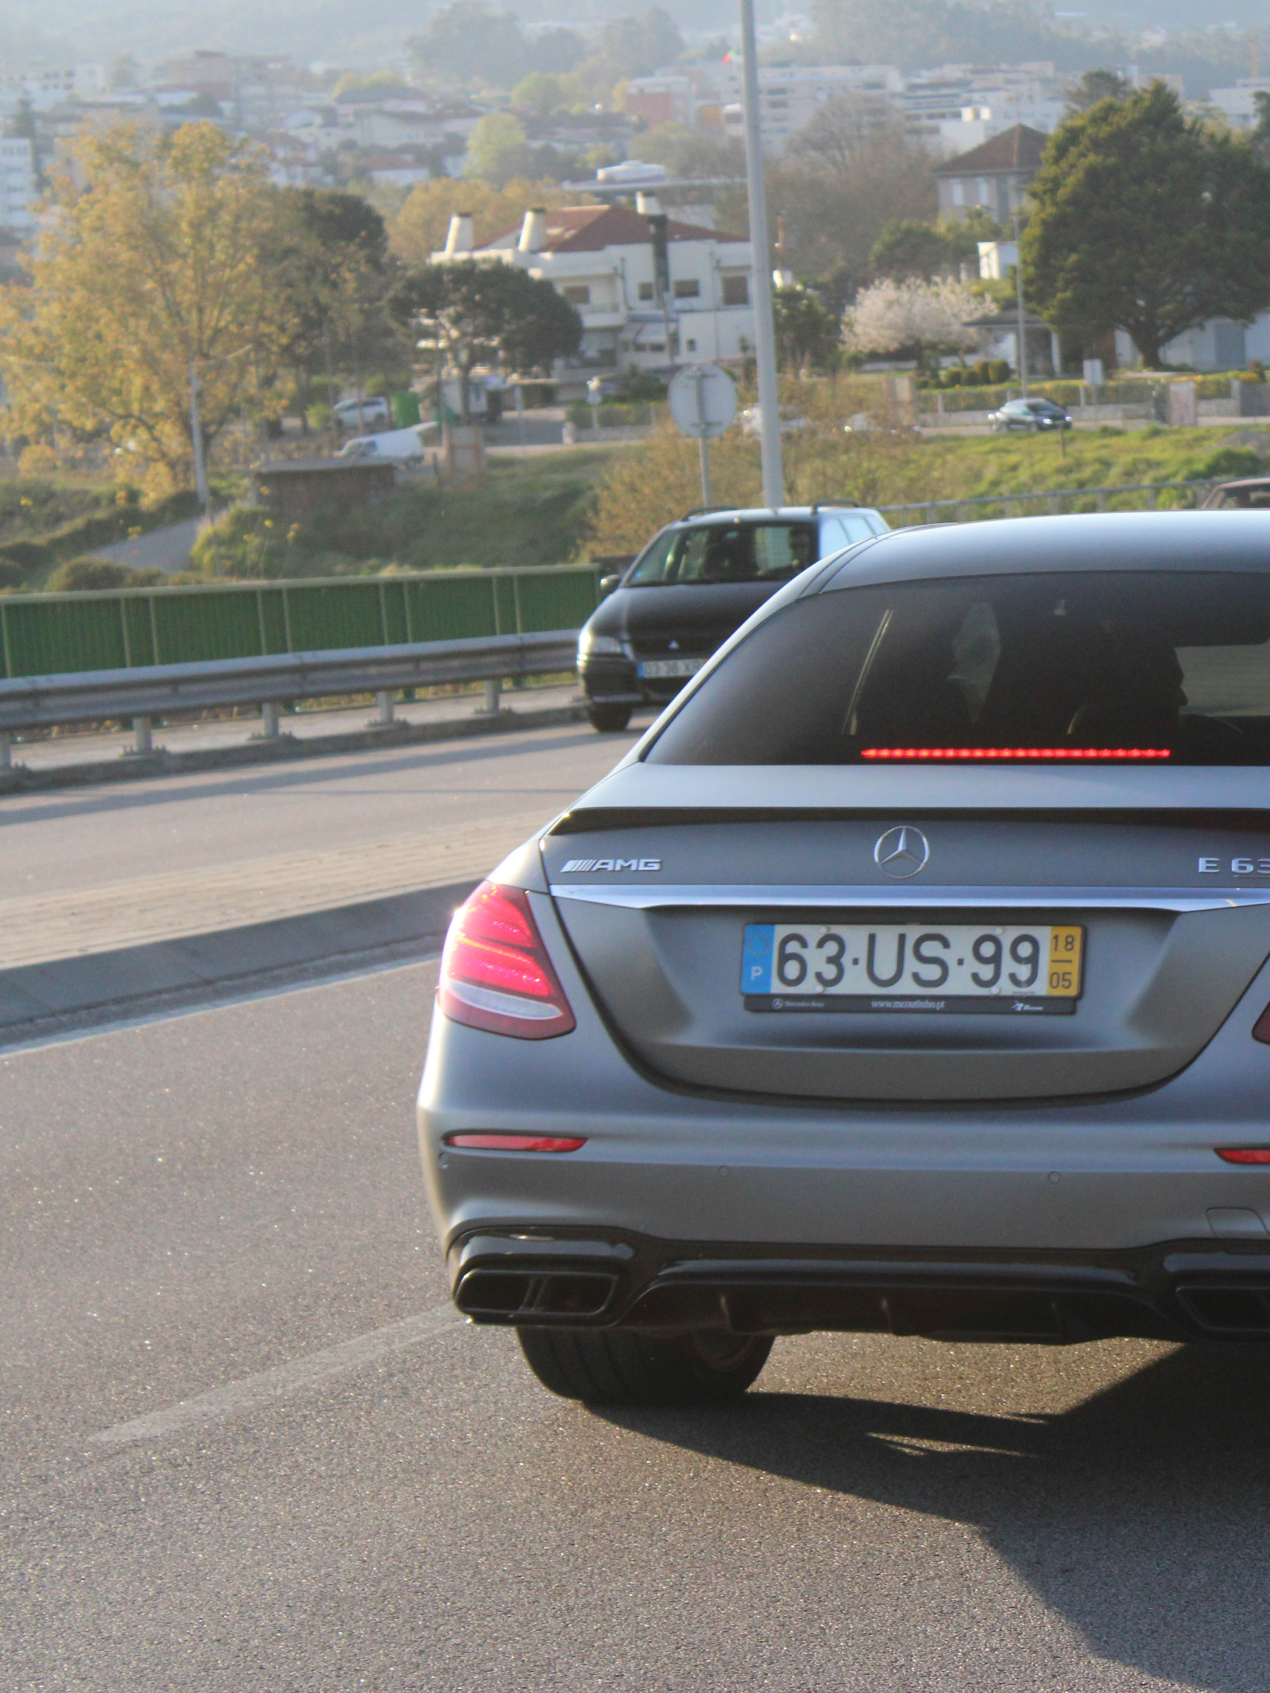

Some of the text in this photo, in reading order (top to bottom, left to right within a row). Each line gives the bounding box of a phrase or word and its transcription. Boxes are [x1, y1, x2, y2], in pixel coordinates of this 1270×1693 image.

[591, 859, 661, 871] AMG
[1199, 857, 1220, 873] E
[1052, 934, 1075, 951] 18
[751, 966, 763, 981] P
[1050, 972, 1072, 990] 05
